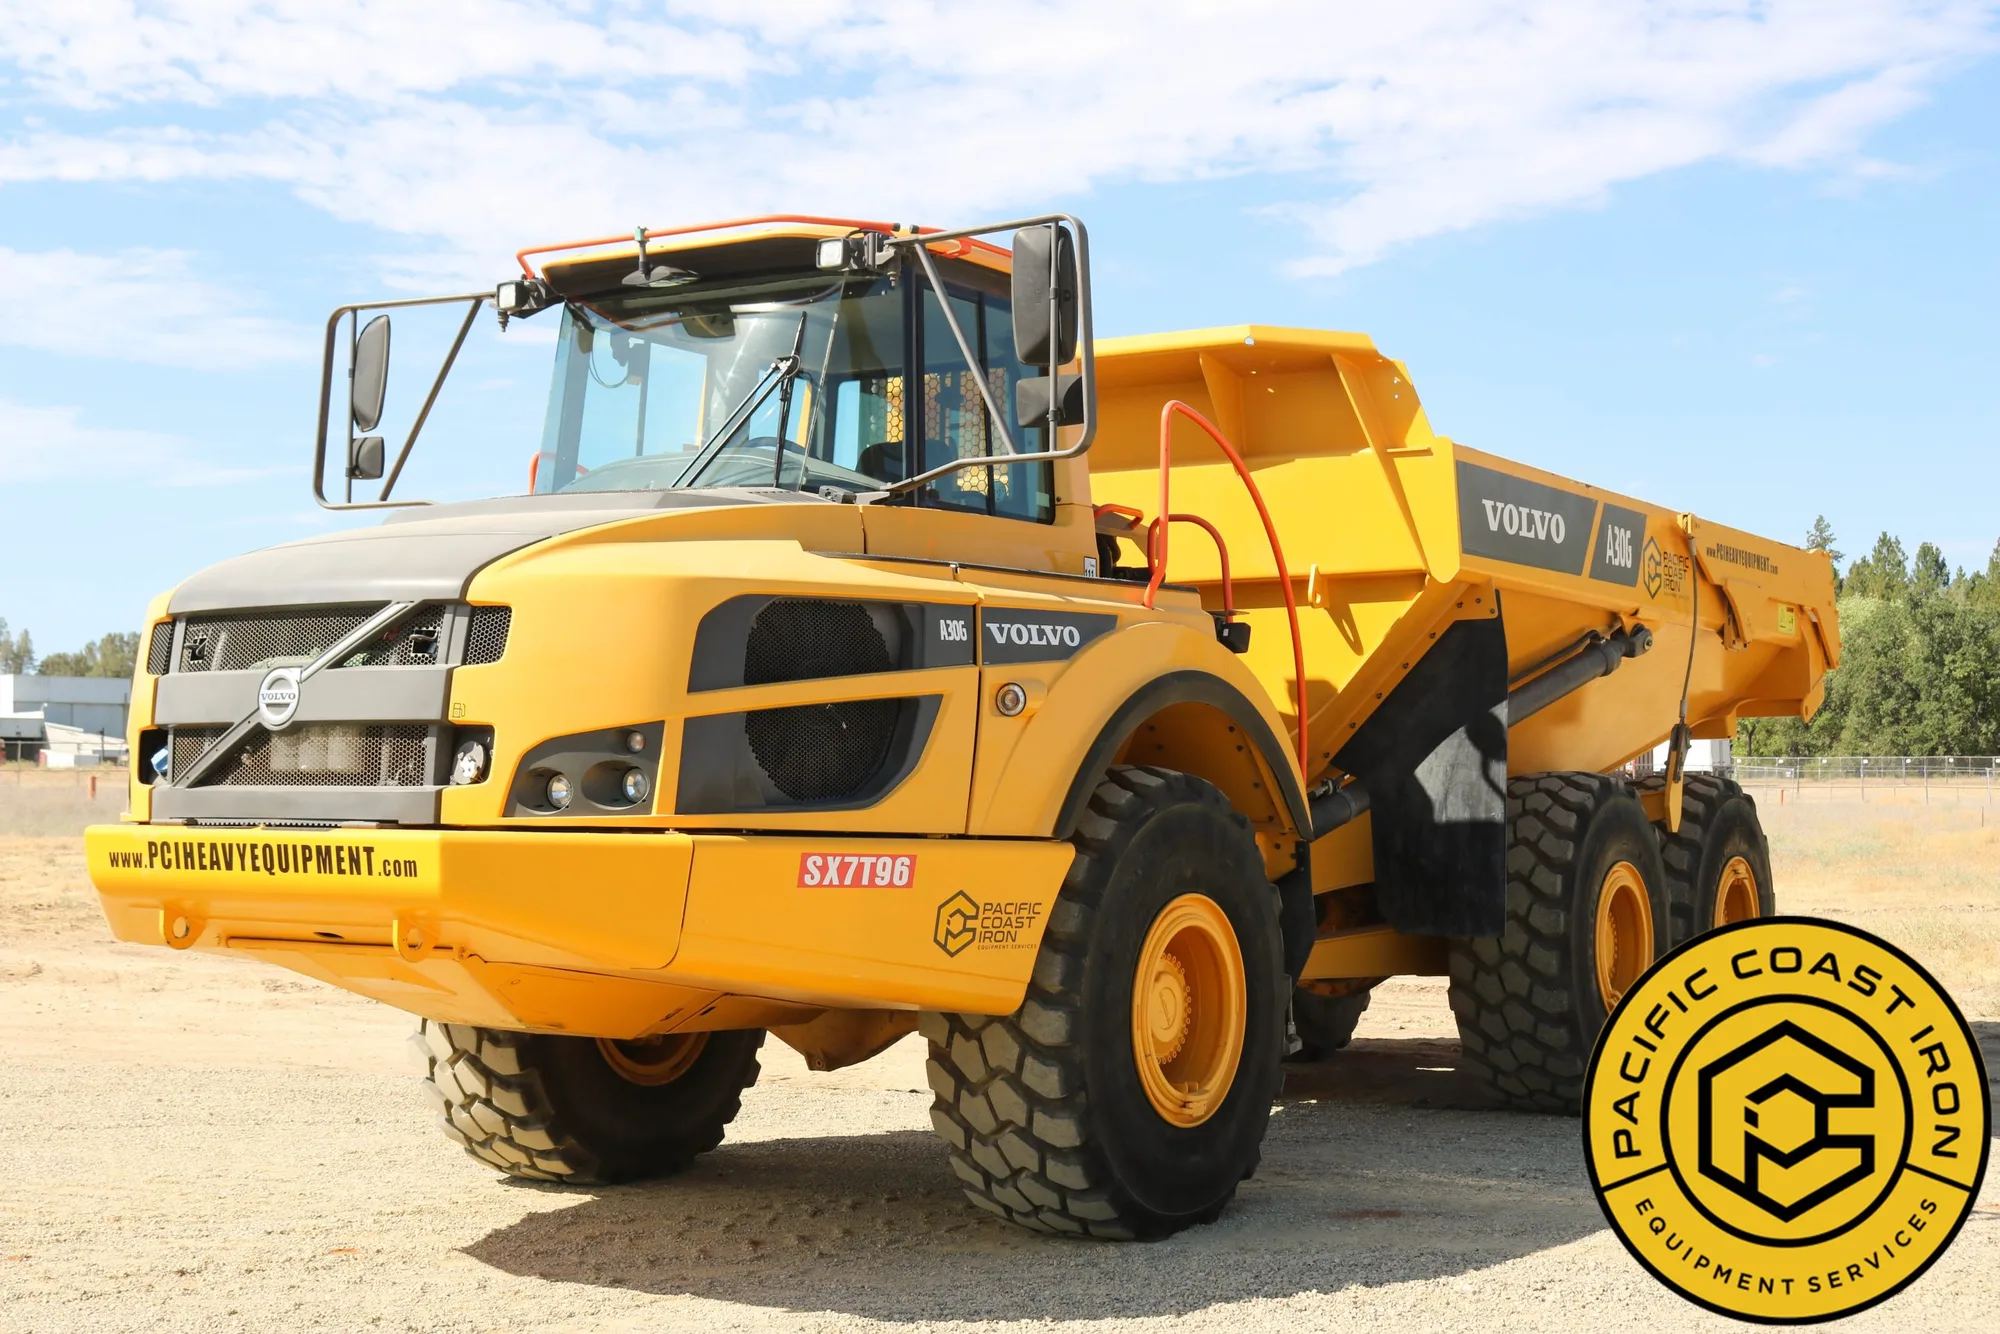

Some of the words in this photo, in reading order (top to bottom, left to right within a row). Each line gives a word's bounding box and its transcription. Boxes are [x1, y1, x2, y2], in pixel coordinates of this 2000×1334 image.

[1482, 499, 1566, 544] VOLVO
[1606, 524, 1632, 569] A30G
[1663, 551, 1690, 568] PACIFIC
[1663, 565, 1687, 580] COAST
[1663, 578, 1681, 592] IRON
[940, 619, 967, 641] A30G
[986, 623, 1080, 647] VOLVO
[261, 692, 296, 701] VOLVO
[109, 841, 418, 878] www.PCIHEAVYEQUIPMENT.com
[804, 855, 911, 886] SX7T96
[982, 902, 1042, 915] PACIFIC
[981, 917, 1036, 929] COAST
[978, 930, 1017, 943] IRON
